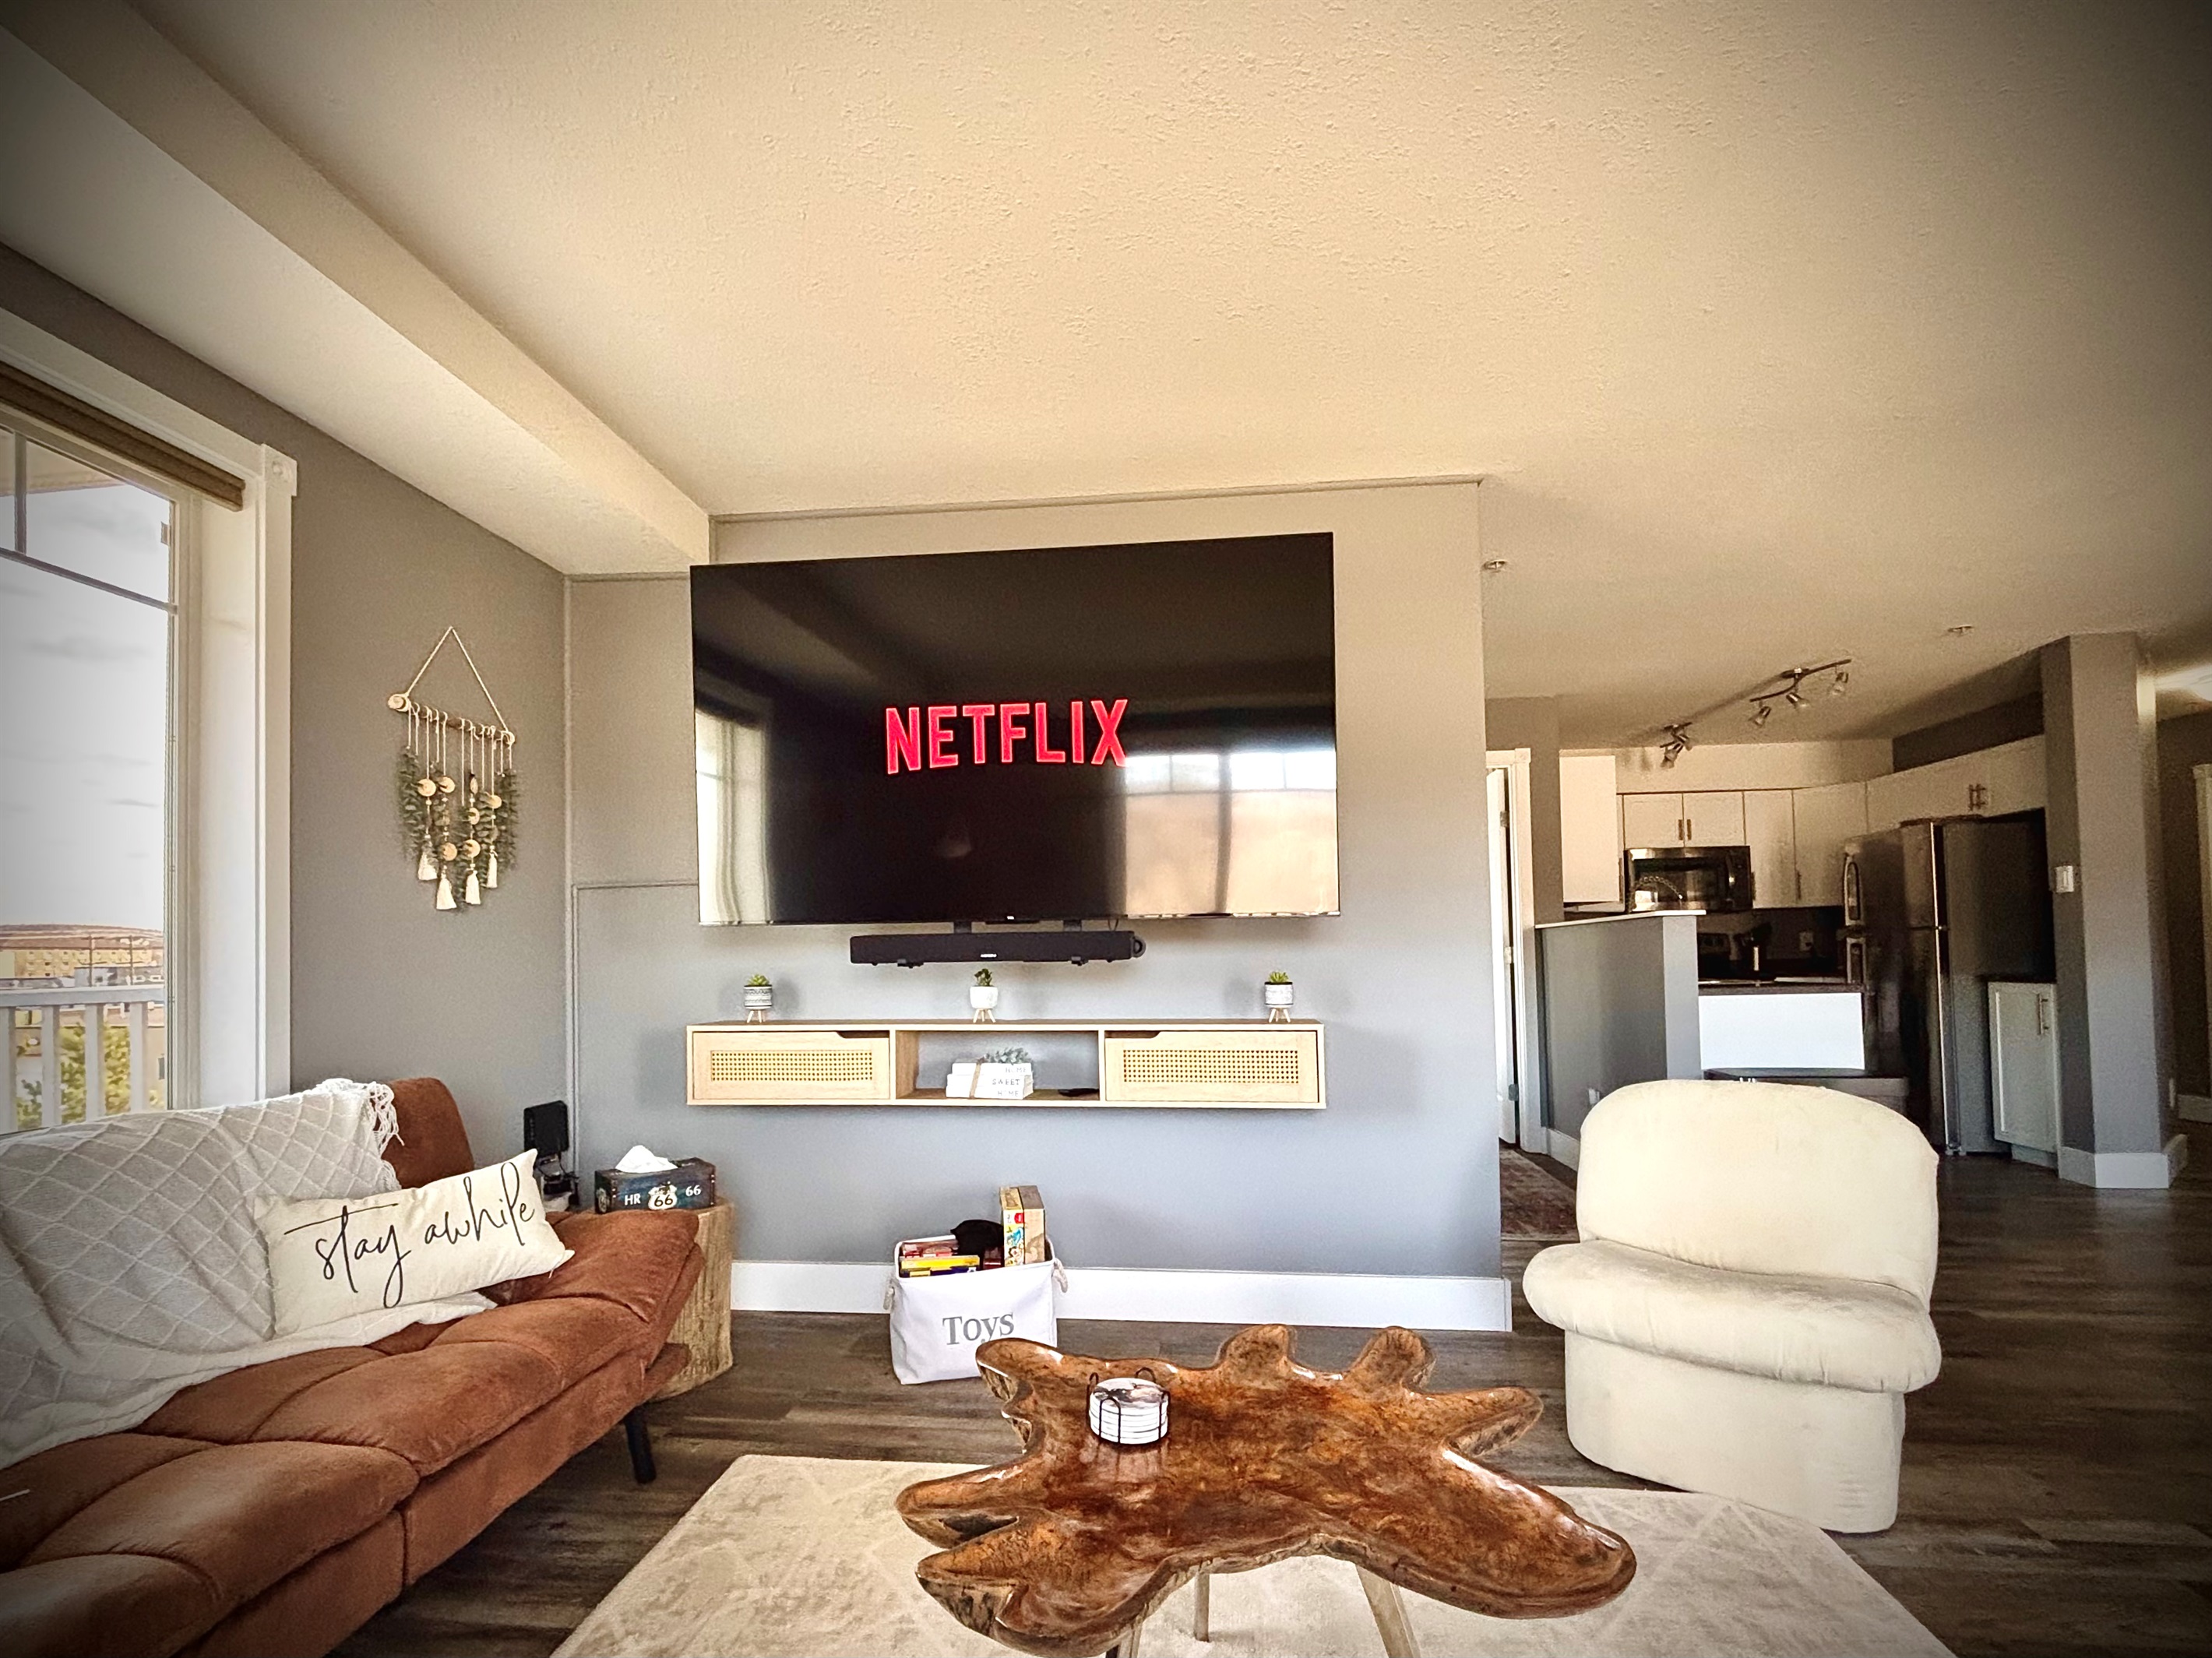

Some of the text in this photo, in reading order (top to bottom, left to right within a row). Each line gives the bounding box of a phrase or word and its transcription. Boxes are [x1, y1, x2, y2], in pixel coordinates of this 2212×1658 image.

[885, 699, 1129, 775] NETFLIX
[624, 1185, 702, 1207] HR 66 66
[284, 1161, 536, 1308] stay awhile
[941, 1311, 1015, 1345] Toys
